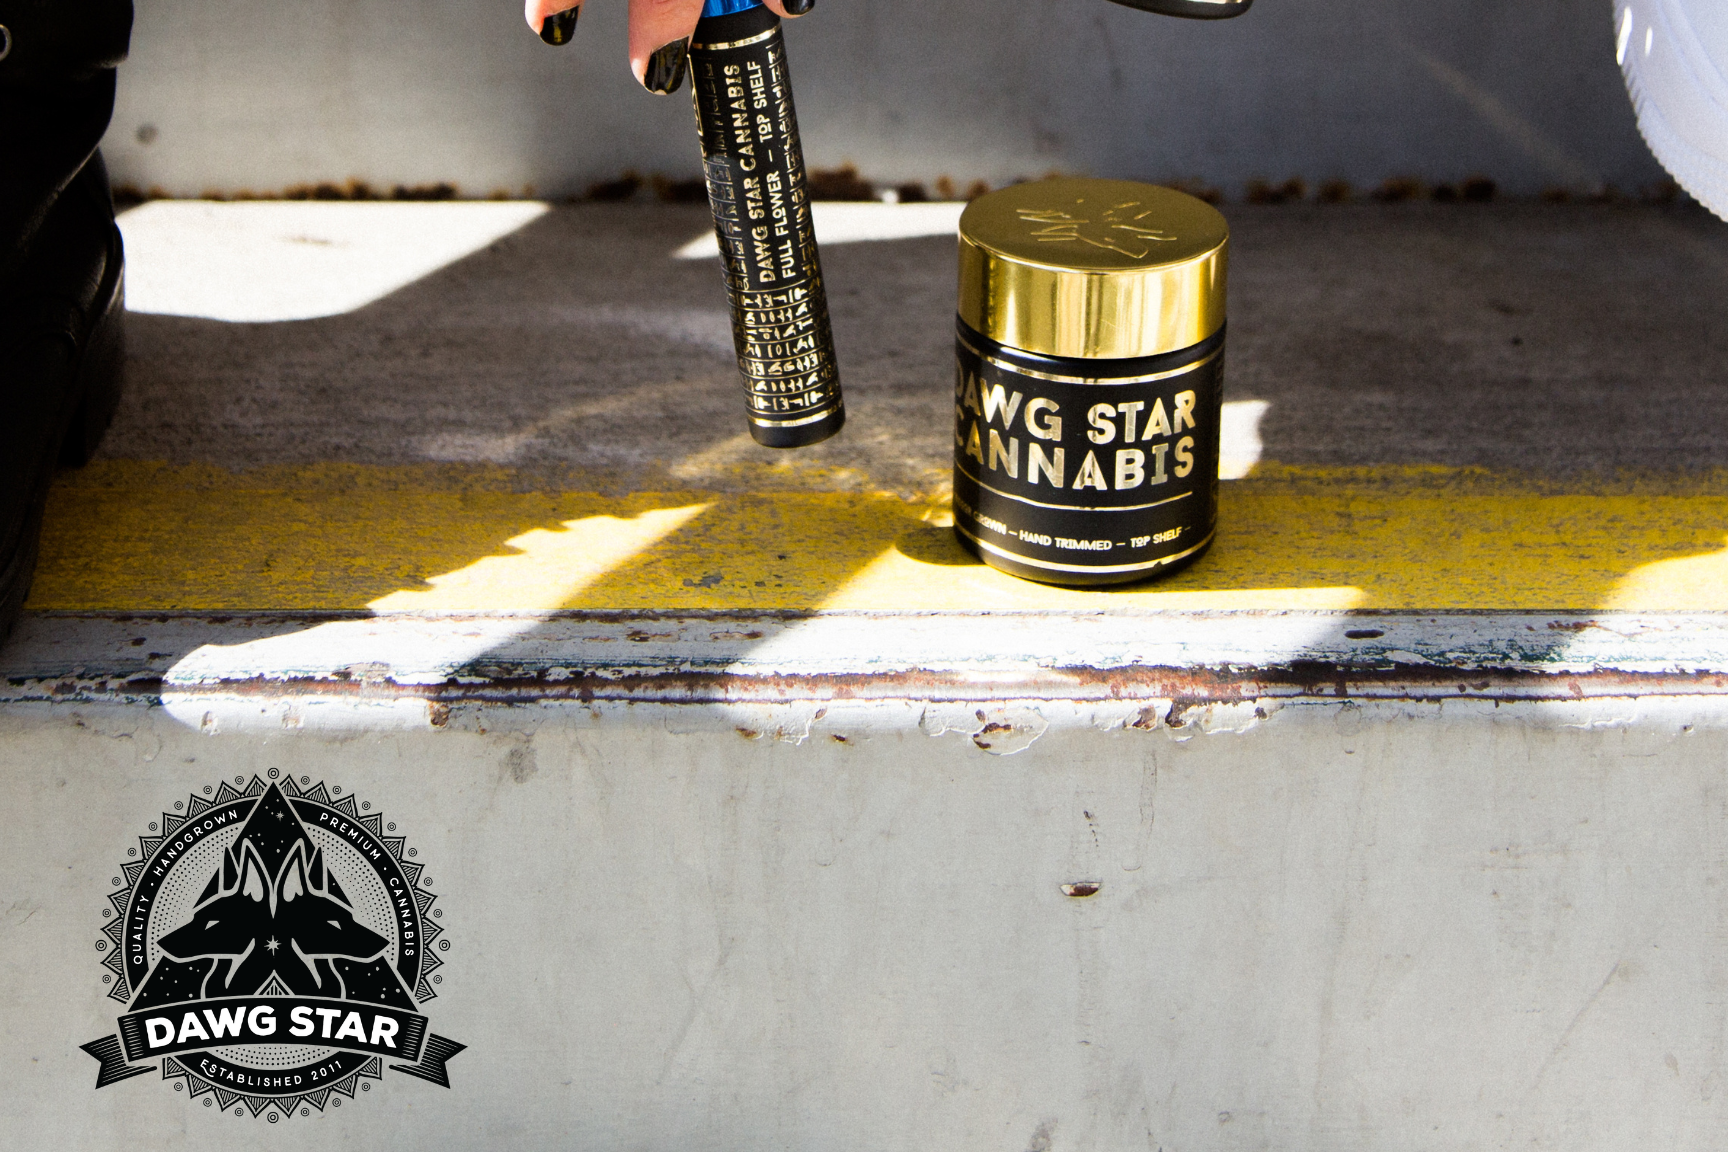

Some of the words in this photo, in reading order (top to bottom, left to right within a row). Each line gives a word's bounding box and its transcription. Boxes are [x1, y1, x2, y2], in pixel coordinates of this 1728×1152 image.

[747, 61, 768, 110] SHELF
[723, 64, 757, 172] CANNABIS
[756, 114, 773, 143] TOP
[743, 177, 765, 220] STAR
[766, 170, 789, 237] FLOWER
[751, 226, 776, 283] DAWG
[778, 239, 796, 279] FULL
[1087, 389, 1196, 444] STAR
[1019, 529, 1052, 547] HAND
[1054, 537, 1113, 551] TRIMMED
[1130, 536, 1151, 548] TOP
[1153, 526, 1182, 545] SHELF
